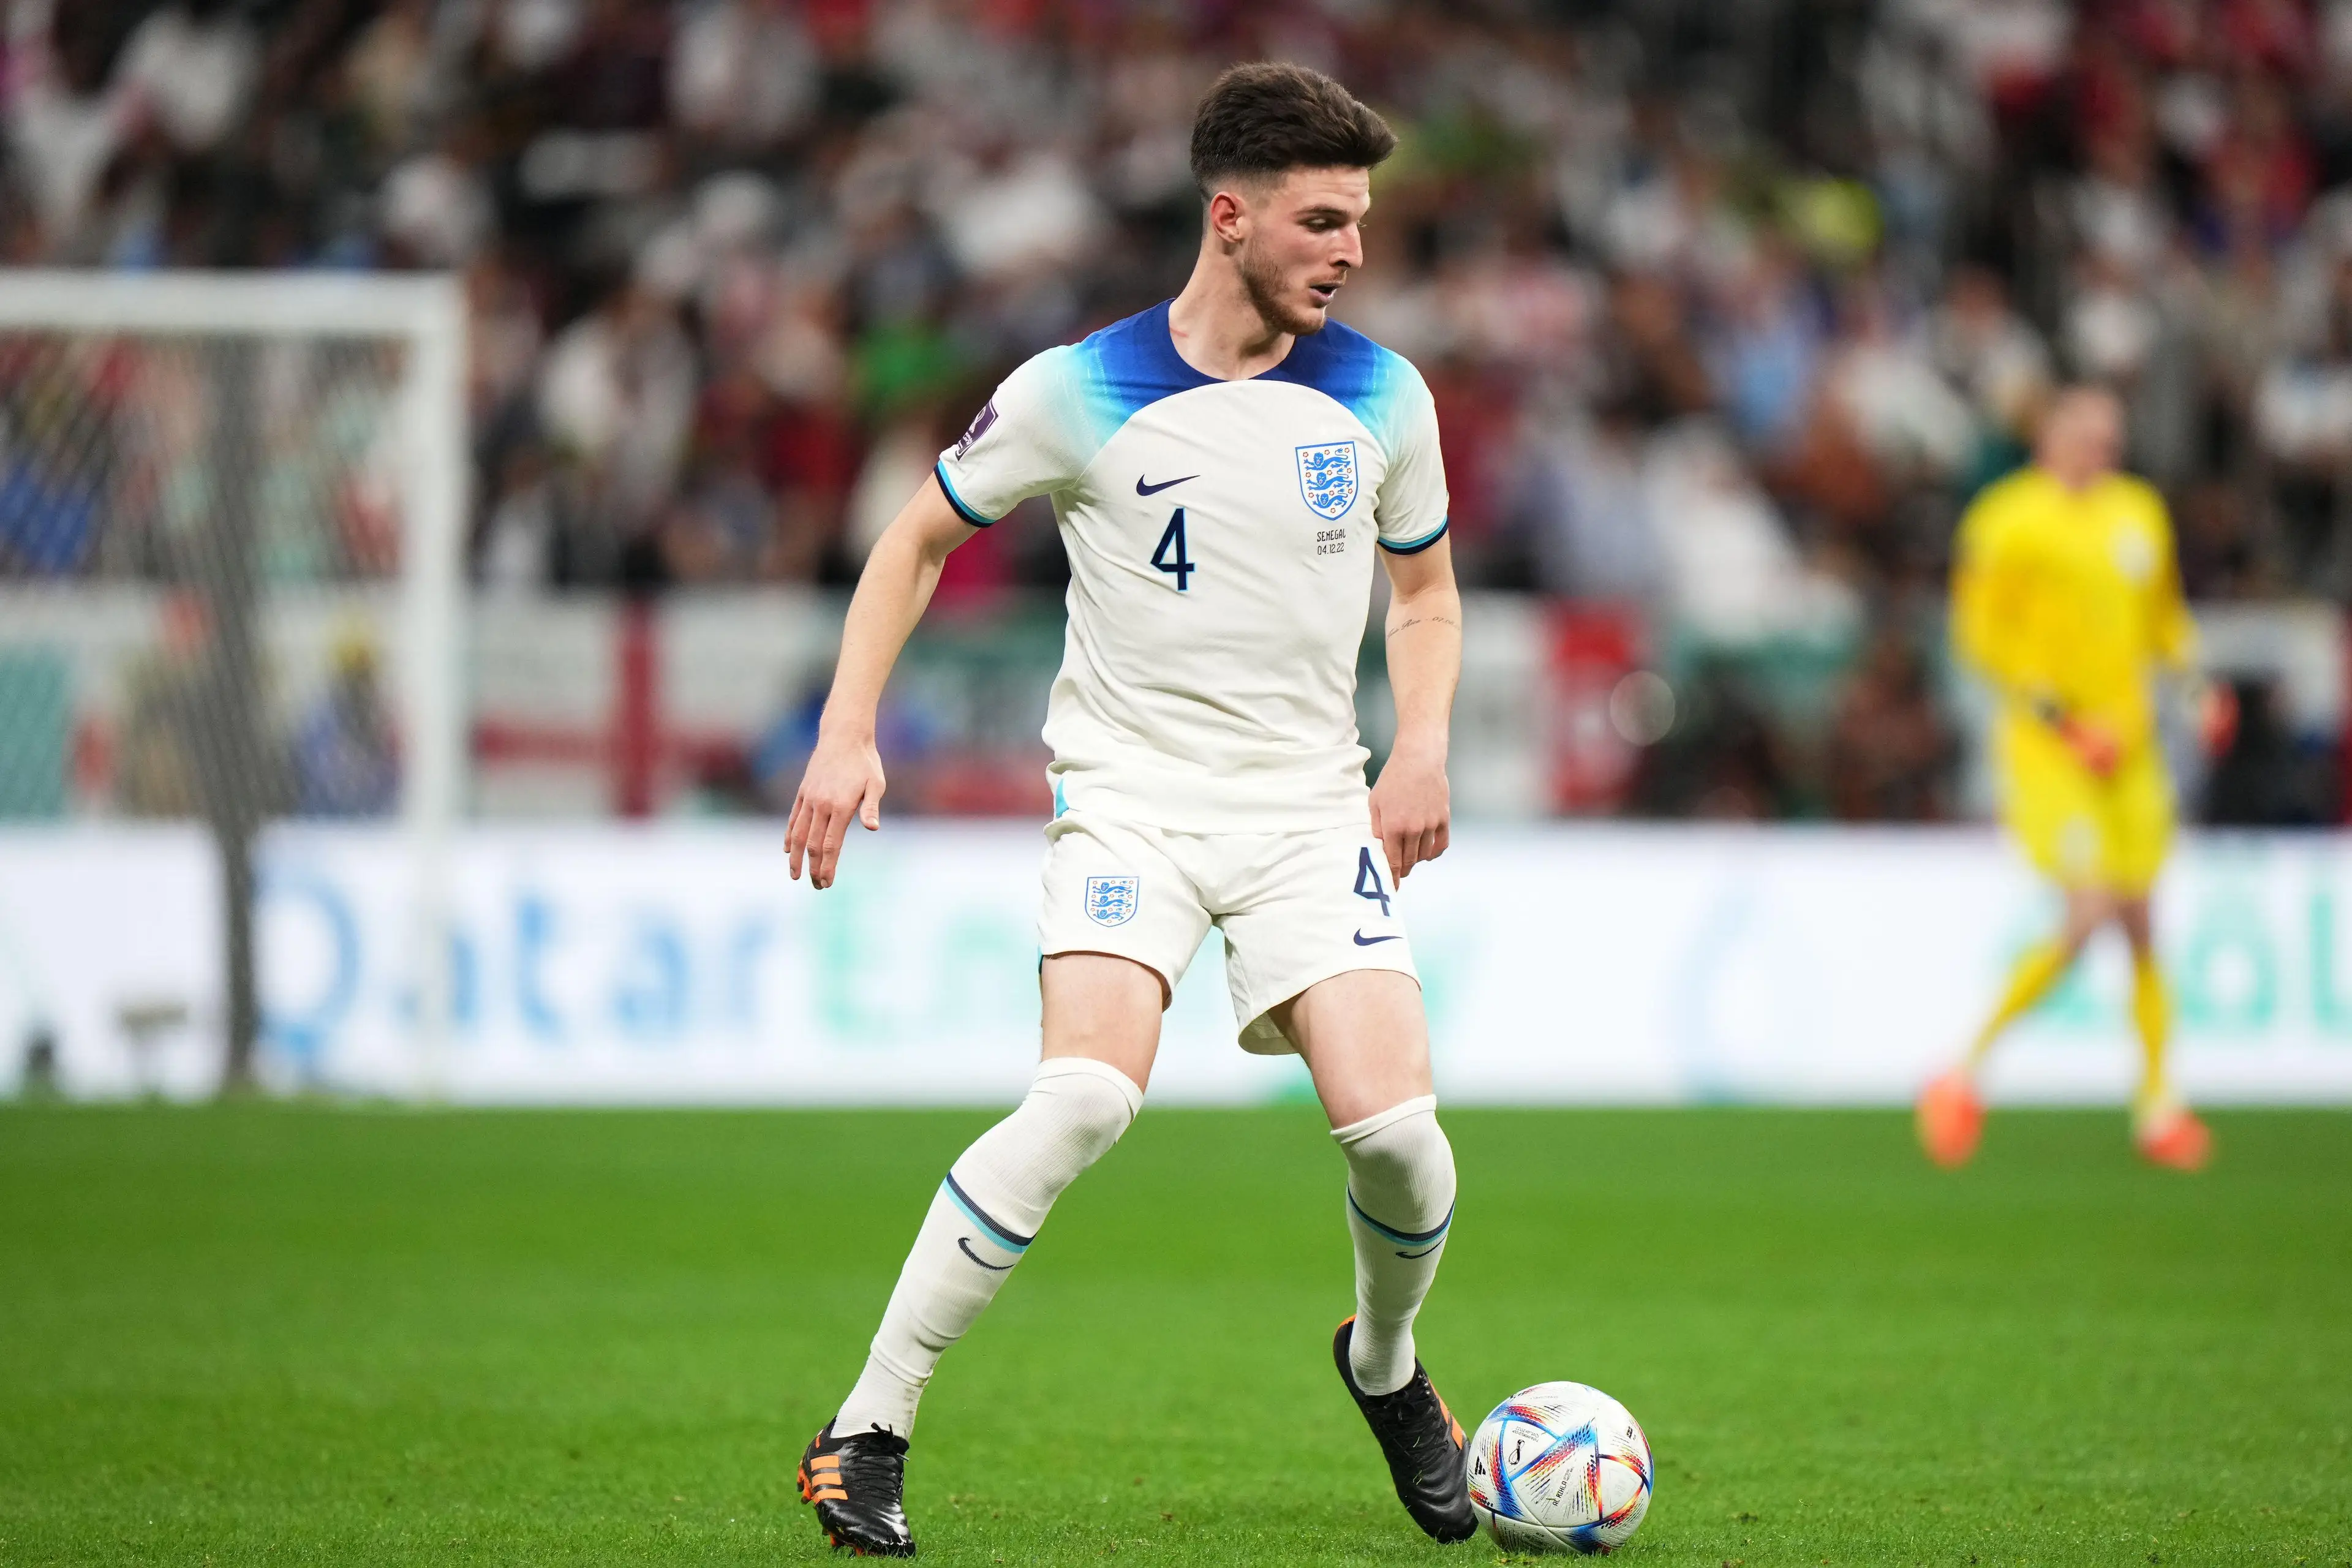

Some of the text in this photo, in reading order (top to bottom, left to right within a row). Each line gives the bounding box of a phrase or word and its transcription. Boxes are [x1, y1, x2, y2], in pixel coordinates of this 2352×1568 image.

[1317, 528, 1346, 542] SENEGAL
[1150, 507, 1195, 592] 4
[1317, 541, 1344, 556] 04.12.22
[1353, 846, 1391, 917] 4
[1556, 1480, 1567, 1498] RIHLA
